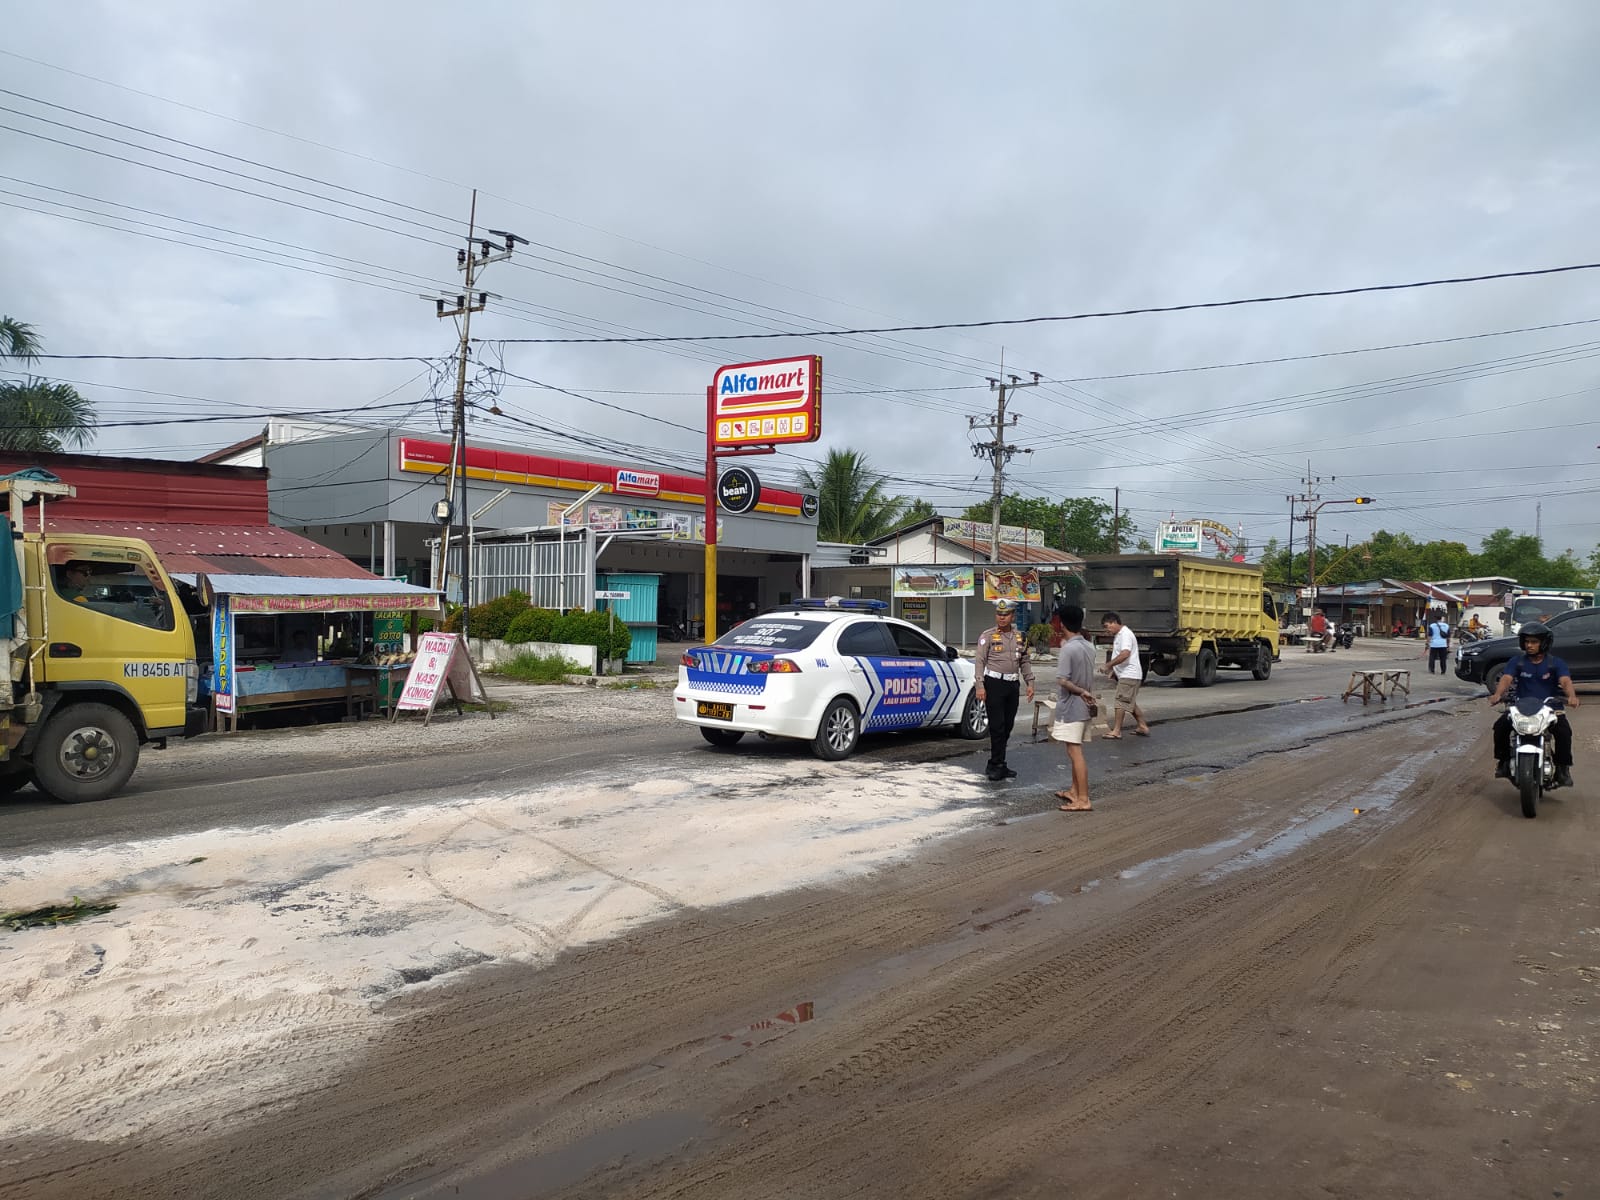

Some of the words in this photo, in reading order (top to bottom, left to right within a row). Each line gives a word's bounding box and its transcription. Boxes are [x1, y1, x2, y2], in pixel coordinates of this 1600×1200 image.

[721, 368, 804, 395] Alfamart
[619, 473, 658, 488] Alfamart
[723, 486, 748, 497] bean!
[754, 628, 782, 636] 907
[424, 640, 450, 654] WADAI
[428, 657, 437, 669] &
[815, 657, 829, 668] WAL
[124, 663, 138, 678] KH
[142, 663, 170, 677] 8456
[173, 662, 184, 676] AT
[415, 672, 439, 685] NASI
[405, 687, 434, 700] KUNING
[884, 678, 922, 696] POLISI
[883, 697, 899, 705] LALU
[899, 696, 920, 704] LINTAS
